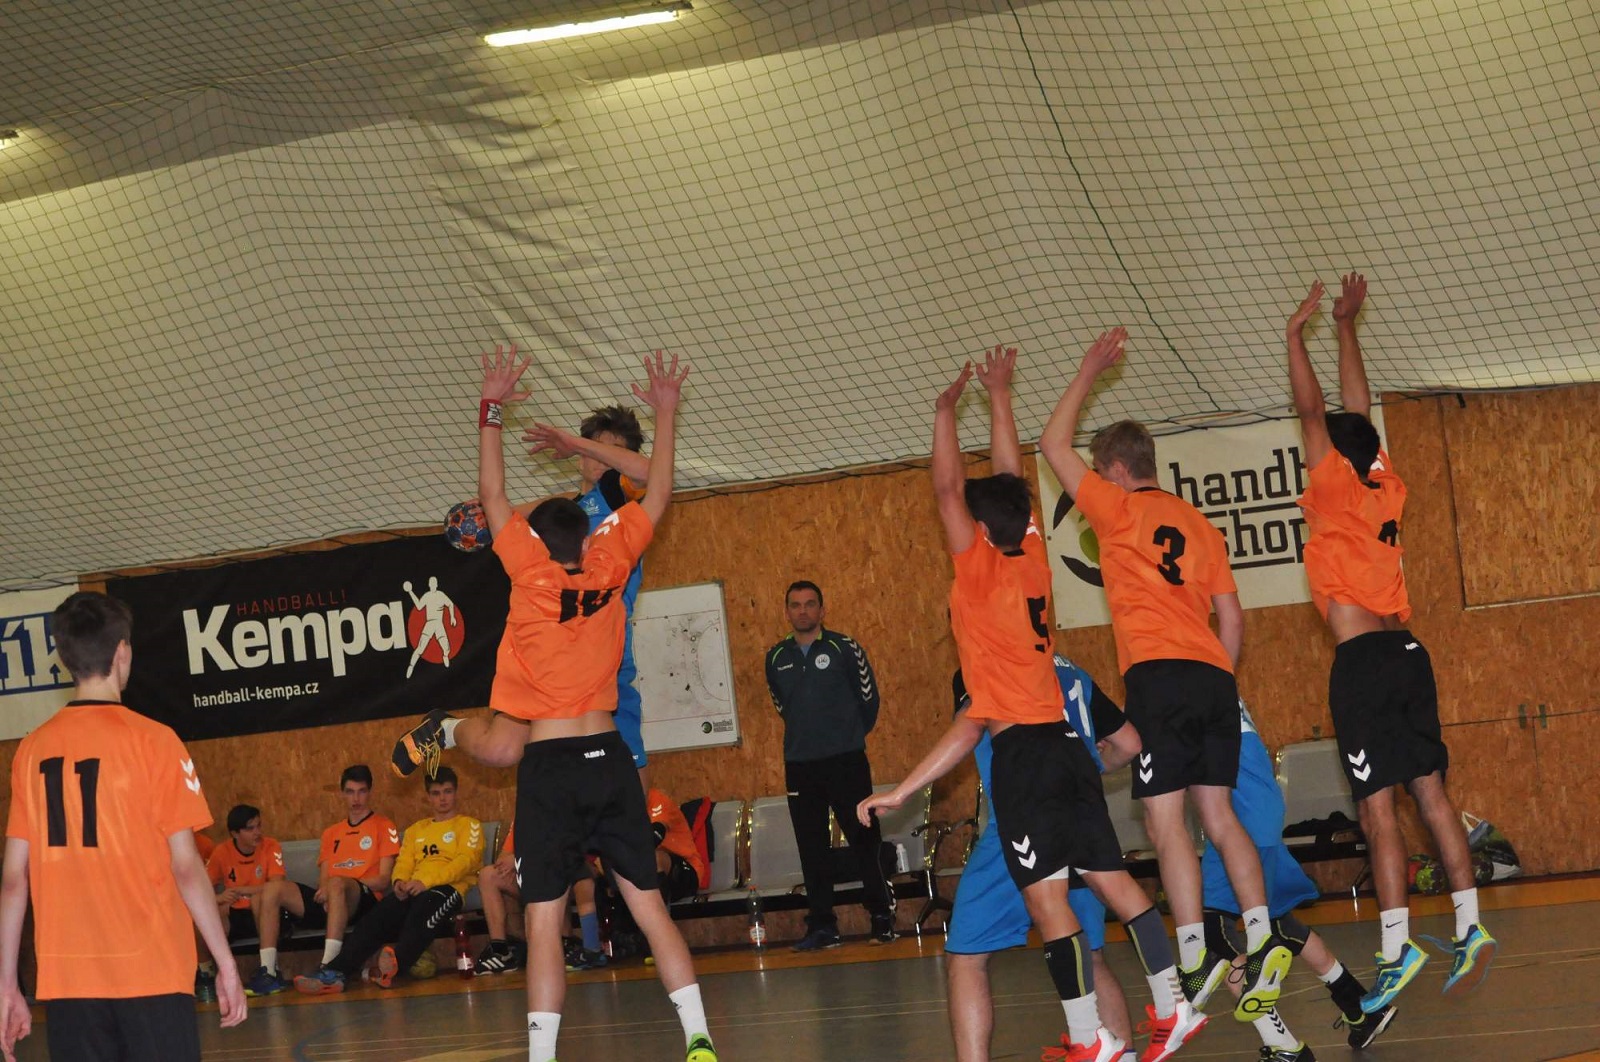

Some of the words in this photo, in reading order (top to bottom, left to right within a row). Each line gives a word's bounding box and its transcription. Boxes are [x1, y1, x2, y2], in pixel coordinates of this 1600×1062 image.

[1153, 525, 1185, 586] 3
[237, 589, 347, 615] HANDBALL!
[183, 600, 407, 677] Kempa
[193, 682, 319, 708] handball-kempa.cz
[39, 756, 101, 847] 11
[333, 839, 340, 854] 7
[422, 844, 439, 859] 16
[228, 867, 237, 882] 4
